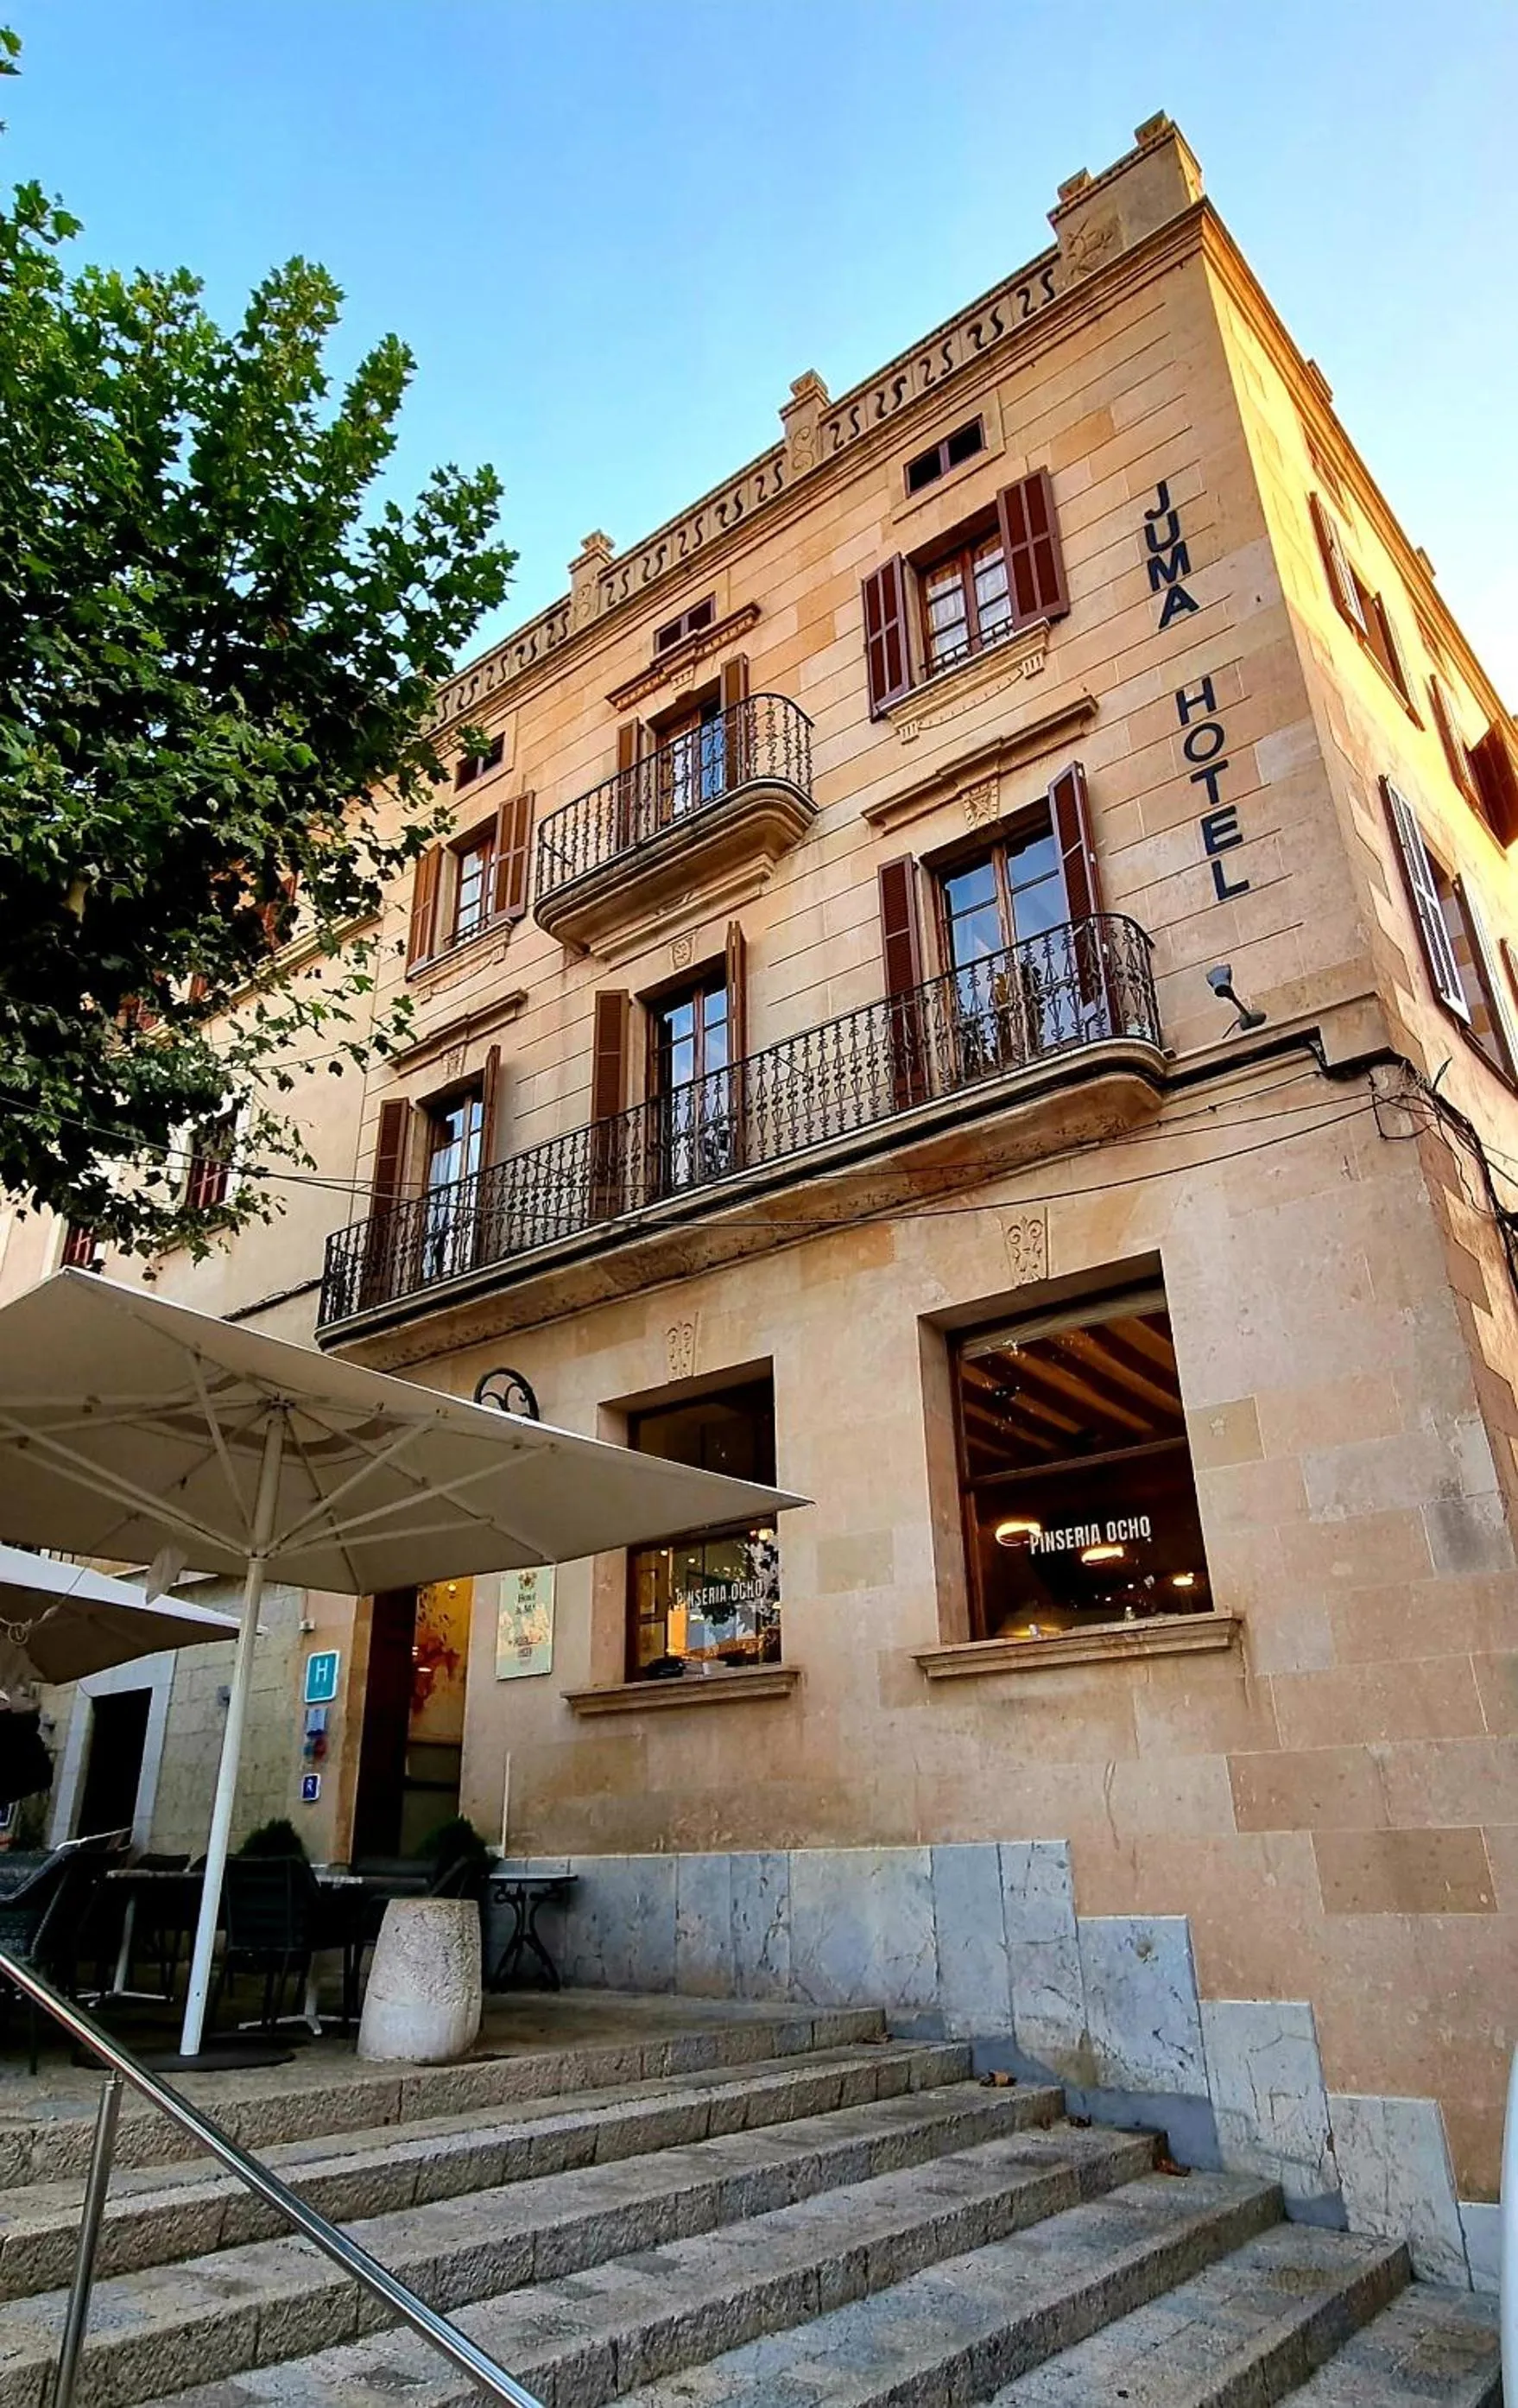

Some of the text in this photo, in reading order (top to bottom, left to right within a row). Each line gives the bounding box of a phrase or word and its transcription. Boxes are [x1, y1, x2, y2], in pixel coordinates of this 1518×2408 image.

[1144, 480, 1249, 901] JUMA HOTEL
[1029, 1515, 1151, 1555] PINSERIA OCHO
[731, 1578, 762, 1601] OCHO
[315, 1657, 328, 1683] H
